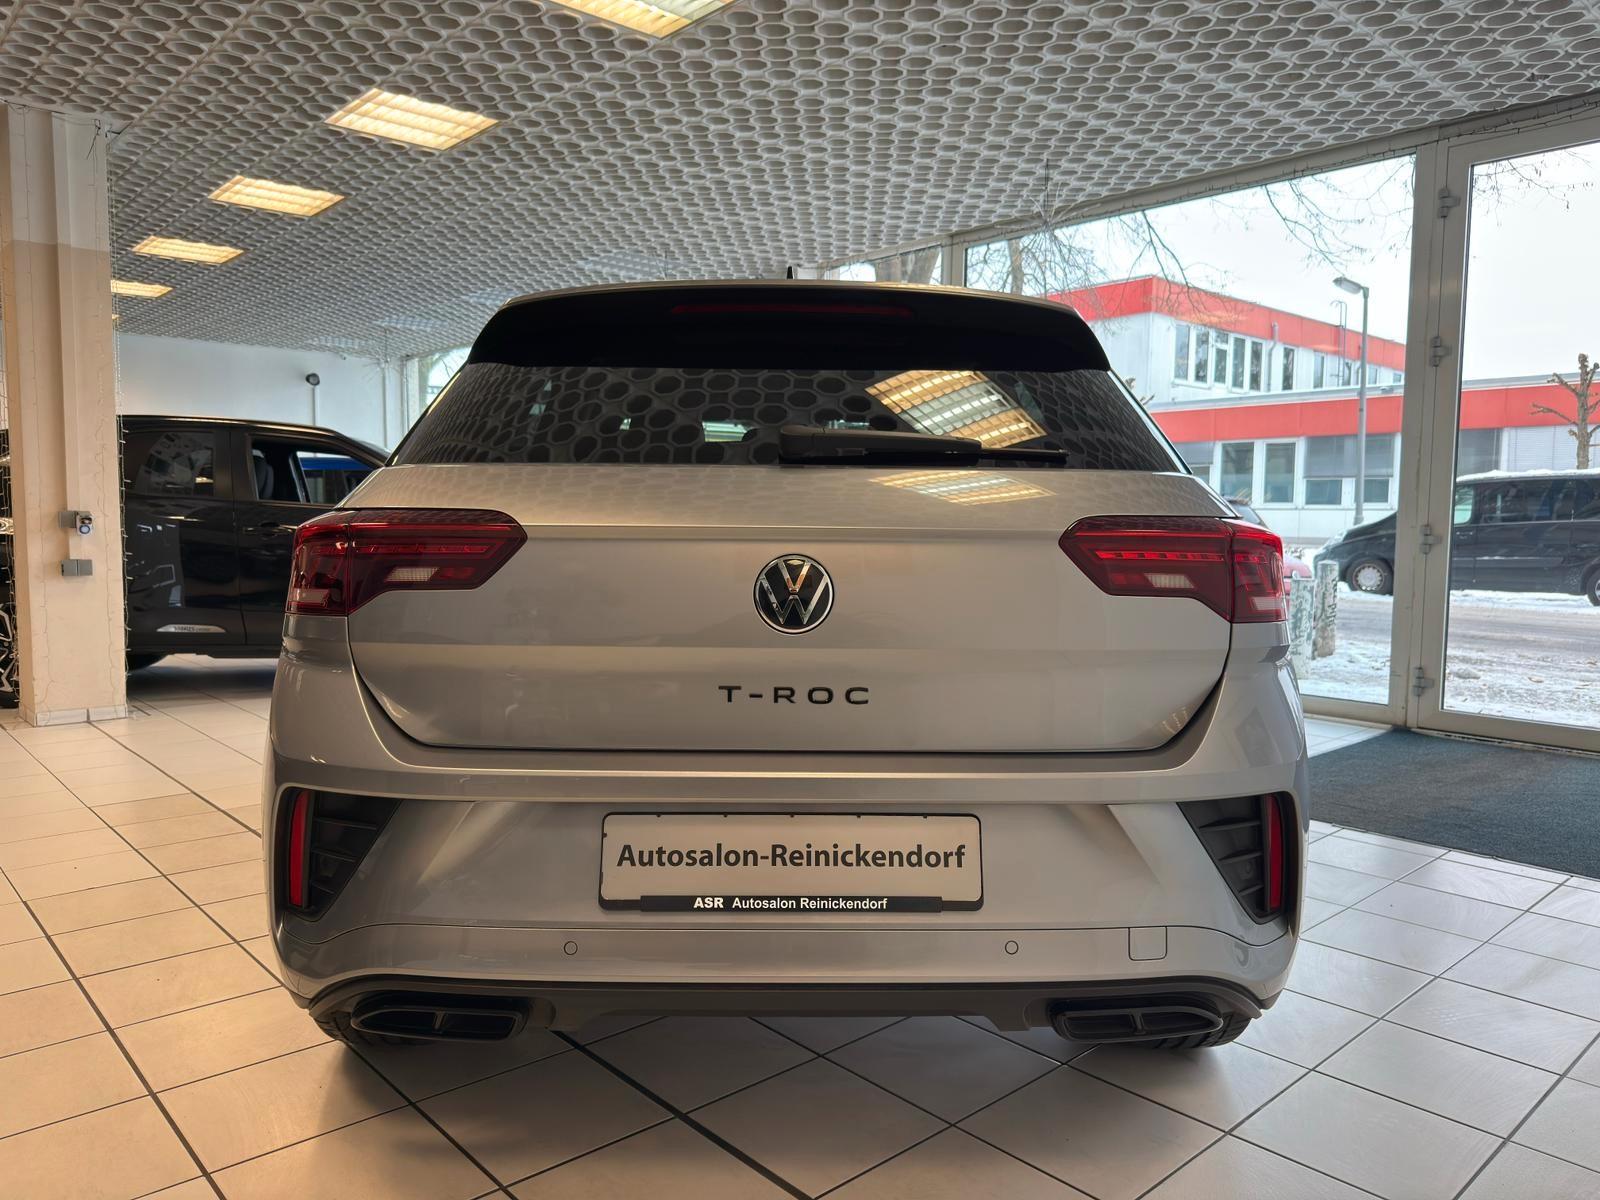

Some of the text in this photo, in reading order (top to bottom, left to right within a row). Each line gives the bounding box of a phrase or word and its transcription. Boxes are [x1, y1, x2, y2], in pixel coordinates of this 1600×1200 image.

[757, 556, 831, 630] VW
[718, 685, 869, 705] T-ROC
[616, 843, 966, 869] Autosalon-Reinickendorf
[693, 897, 888, 910] ASR Autosalon Reinickendorf
